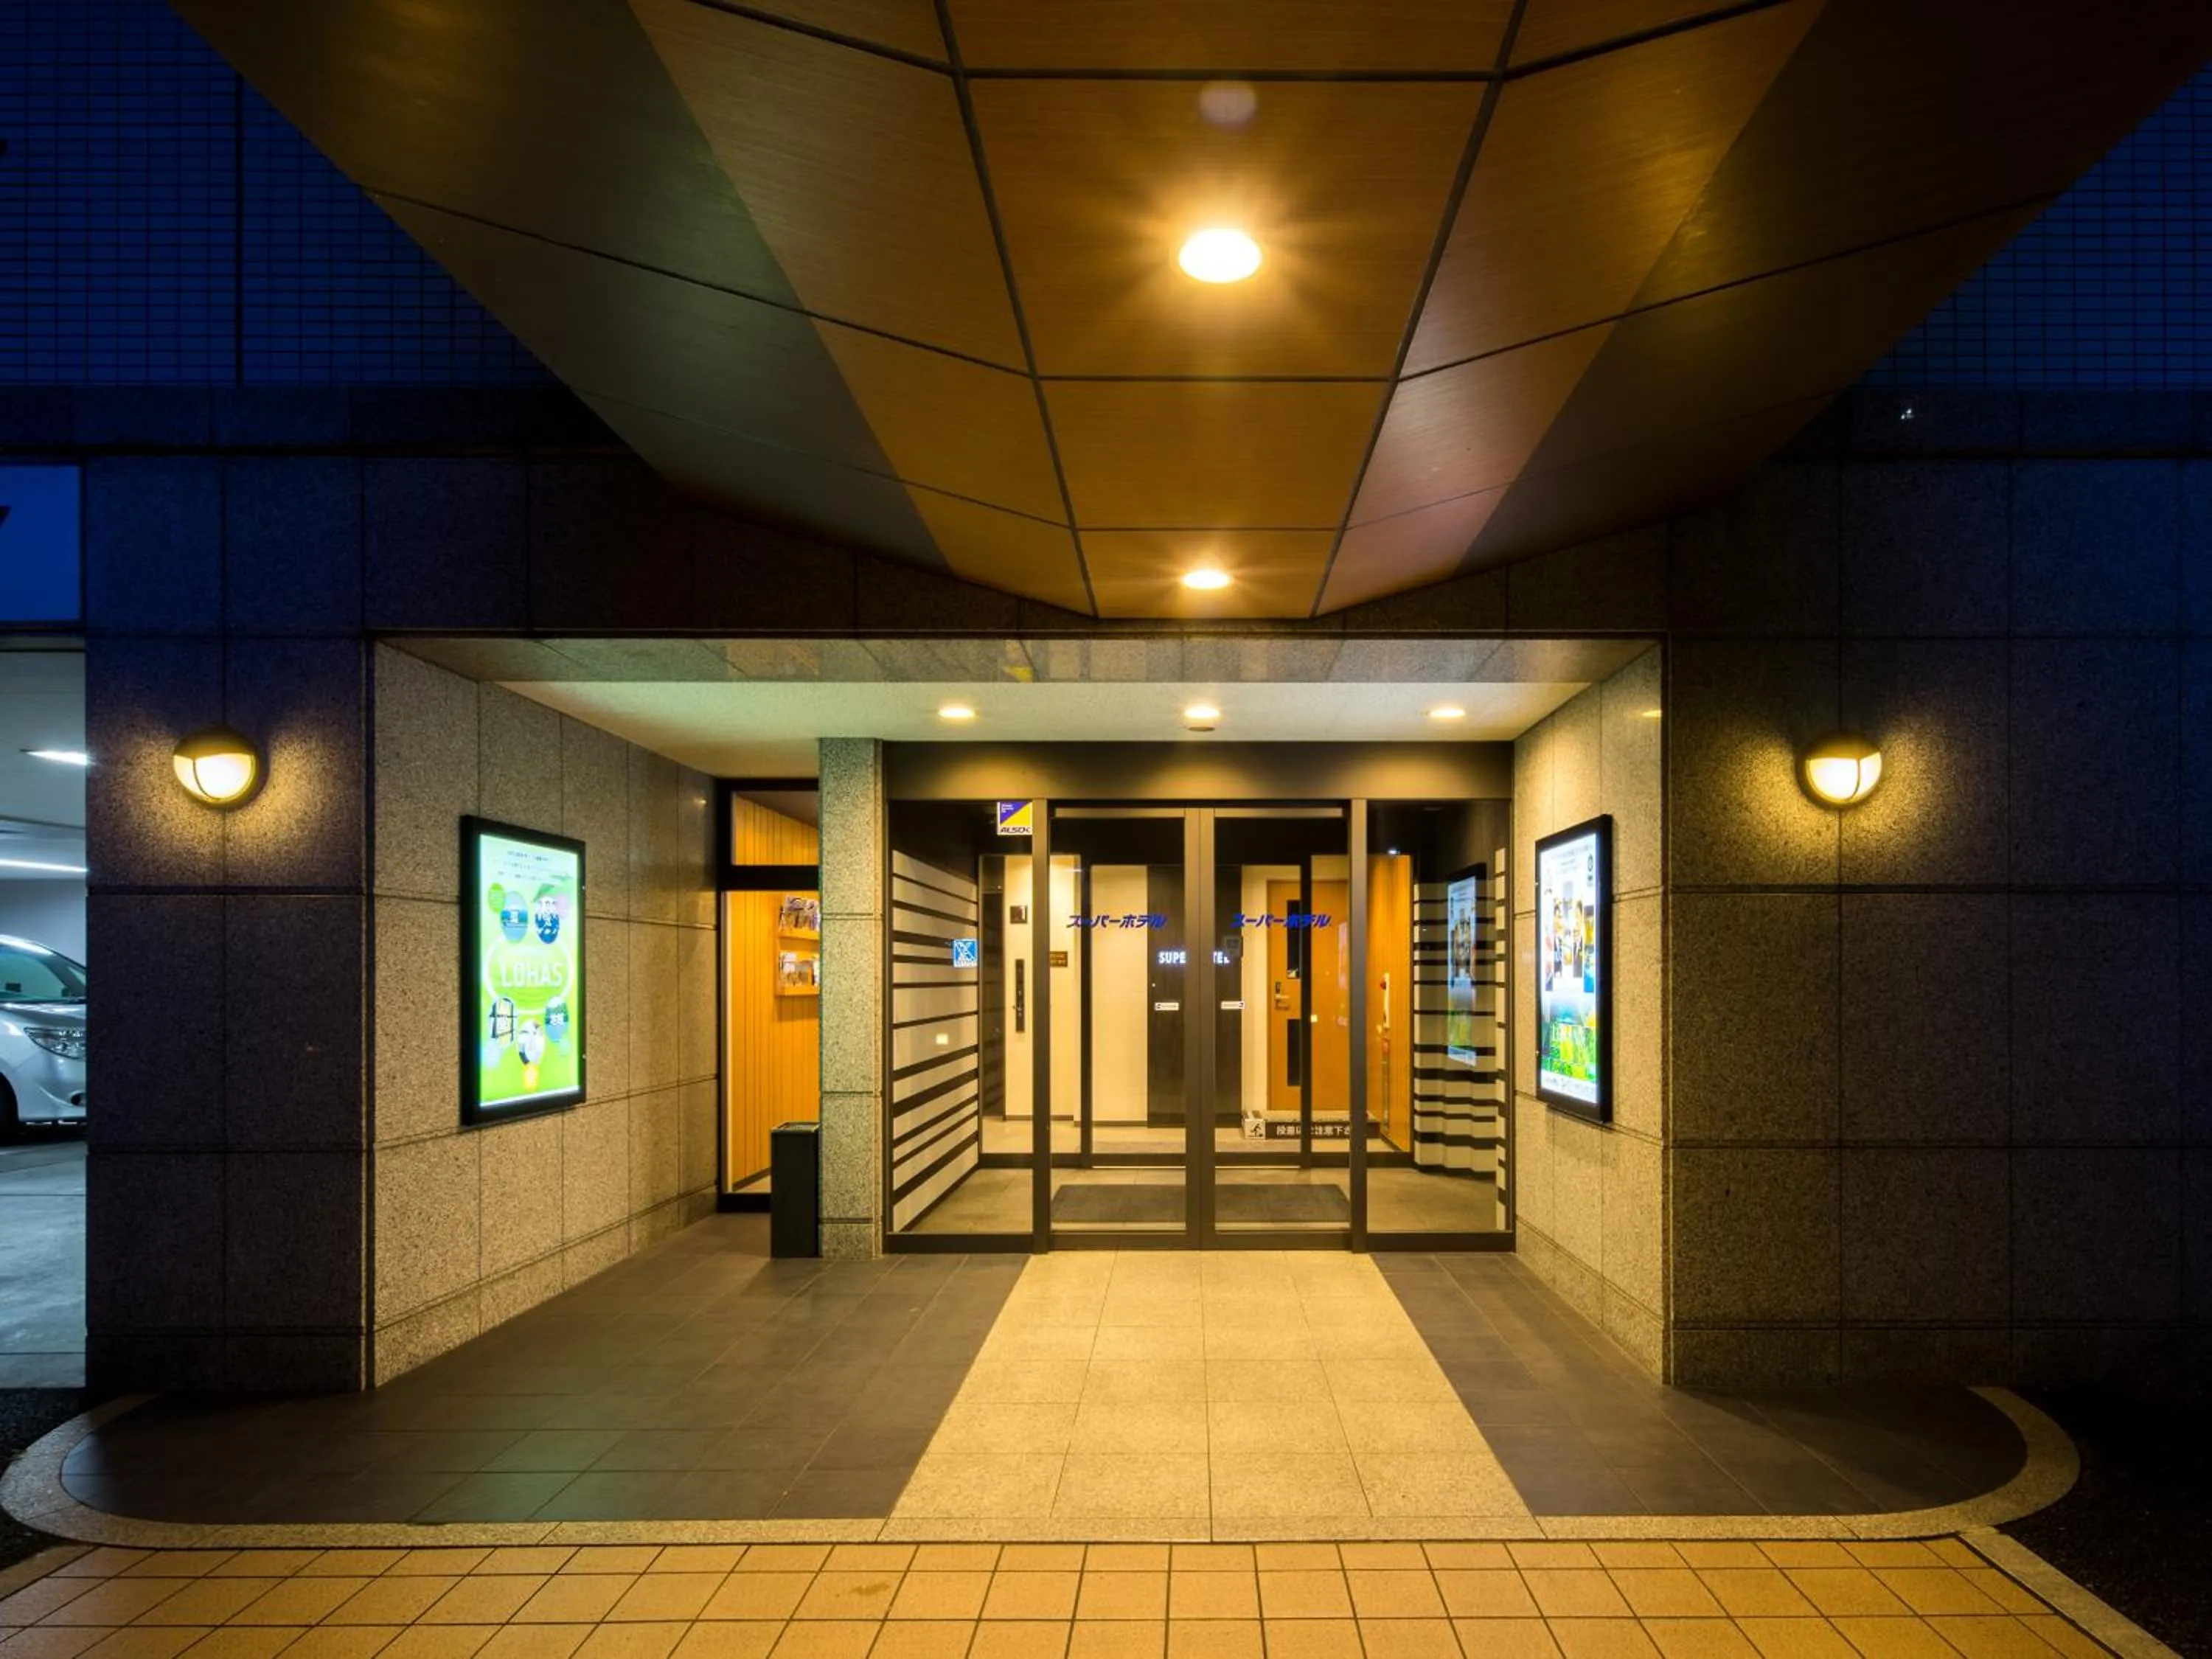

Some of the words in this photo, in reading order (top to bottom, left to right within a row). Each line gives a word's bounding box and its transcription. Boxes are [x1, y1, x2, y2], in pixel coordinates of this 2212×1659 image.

[1066, 914, 1166, 928] スーパーホテル
[1229, 913, 1332, 928] スーパーホテル
[1158, 951, 1186, 964] SUPE
[499, 959, 563, 988] LOHAS
